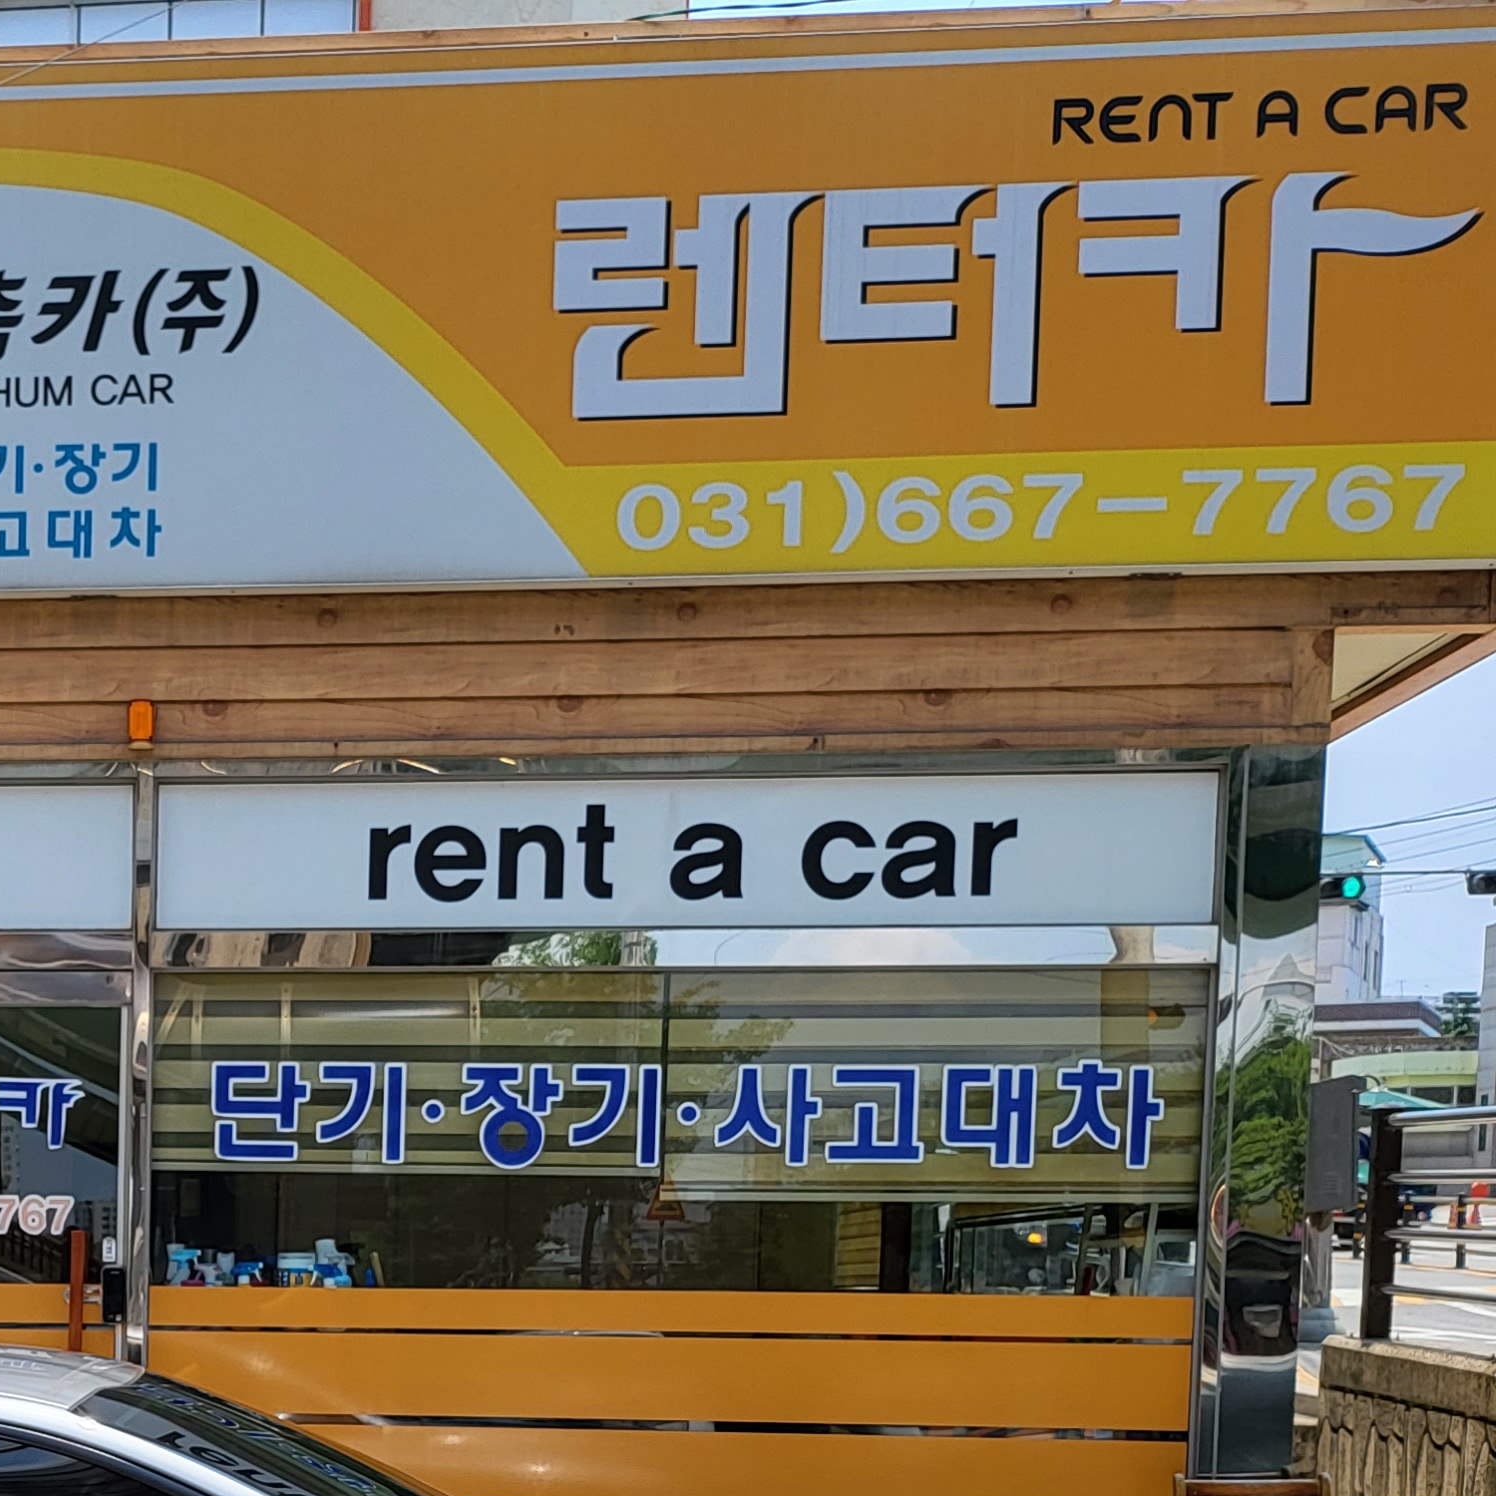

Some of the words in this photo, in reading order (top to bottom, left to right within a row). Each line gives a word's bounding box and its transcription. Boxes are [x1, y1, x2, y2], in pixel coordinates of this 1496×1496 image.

[1052, 93, 1234, 145] RENT
[1257, 90, 1299, 138] A
[1324, 82, 1468, 134] CAR
[553, 172, 1482, 421] 렌터카
[90, 373, 175, 405] CAR
[616, 463, 1465, 555] 031)667-7767
[368, 804, 615, 903] rent
[669, 821, 743, 901] a
[801, 818, 1018, 900] car
